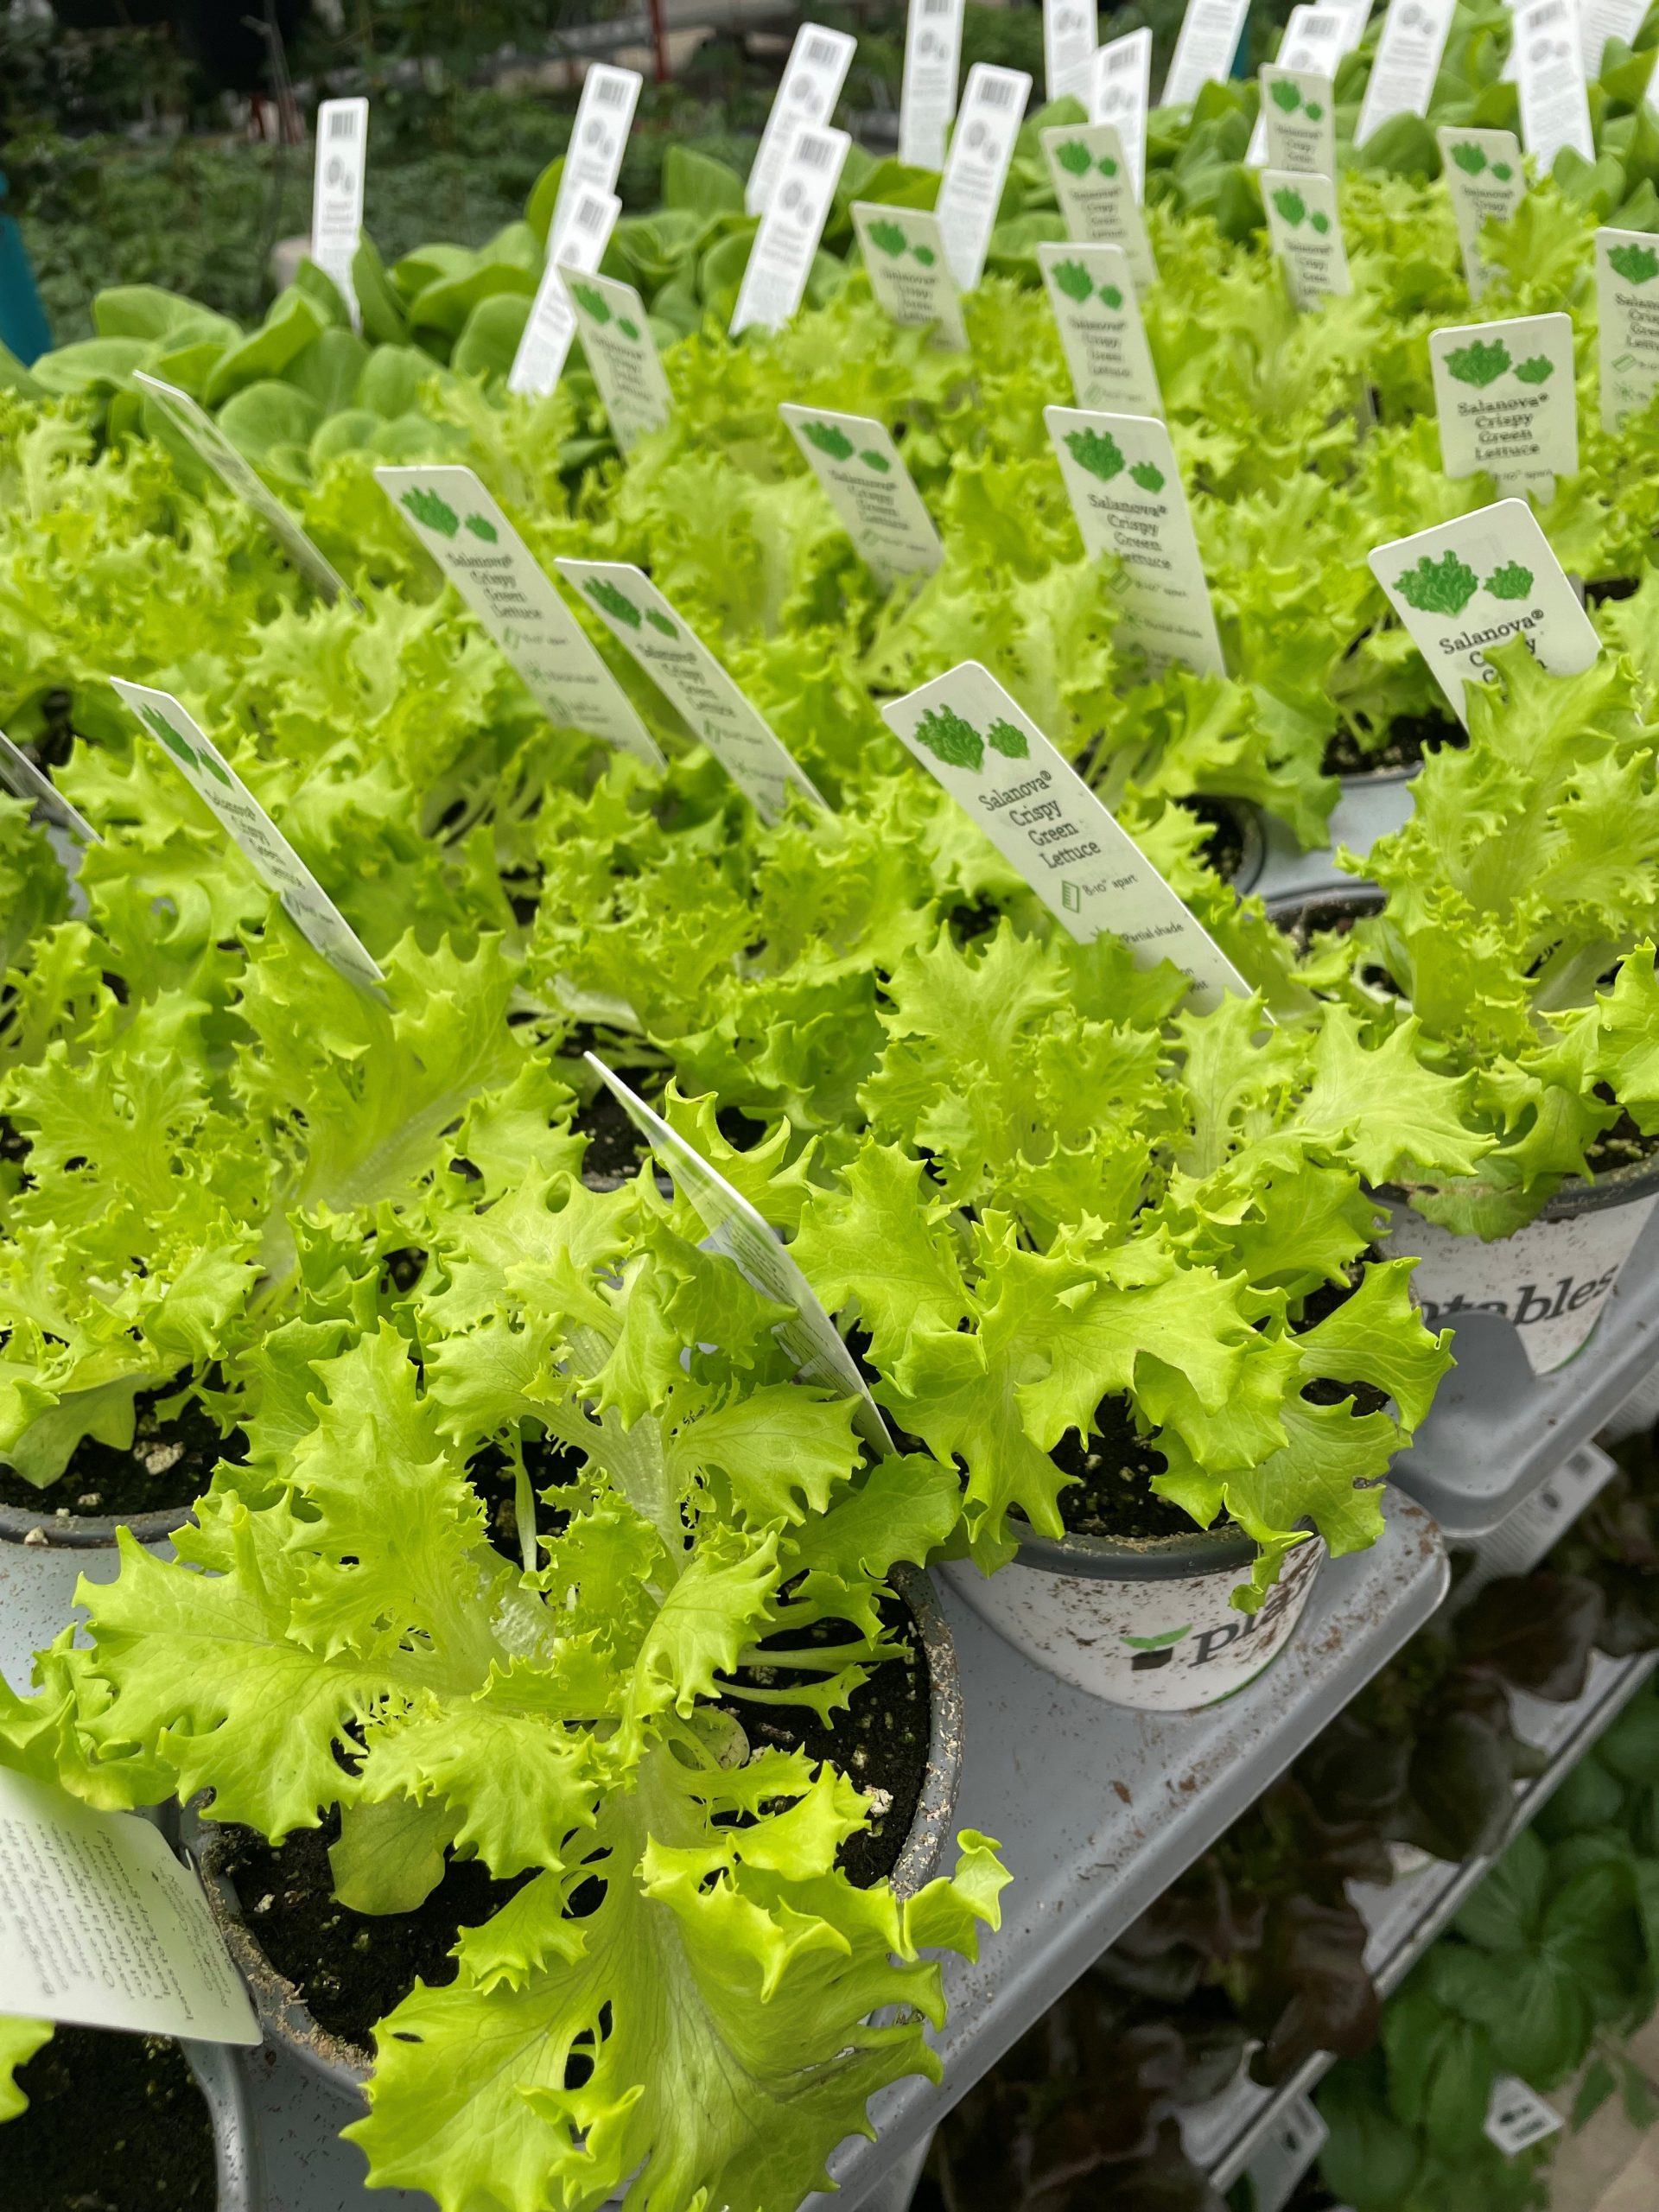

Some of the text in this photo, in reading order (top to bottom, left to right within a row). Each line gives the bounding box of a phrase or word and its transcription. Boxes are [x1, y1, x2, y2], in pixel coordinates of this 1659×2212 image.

[1475, 413, 1533, 429] Crispy
[1478, 429, 1533, 444] Green
[1475, 444, 1541, 461] Lettuce
[1107, 513, 1159, 537] Crispy
[1114, 531, 1162, 551] Green
[1115, 548, 1172, 569] ettuce
[1008, 798, 1062, 827] Crispy
[1028, 822, 1079, 847] Green
[1039, 841, 1102, 869] Lettuce
[1110, 874, 1138, 889] apart
[63, 1859, 96, 1908] larger
[34, 1823, 118, 1988] Once the head has
[62, 1829, 148, 1997] cut the outer leaves
[90, 1843, 172, 1995] leaving the central
[105, 1894, 125, 1923] the
[134, 1902, 160, 1941] keep
[56, 1908, 96, 1980] amount
[121, 1926, 152, 1979] above
[93, 1927, 137, 1999] reached
[164, 1967, 196, 2020] leaves
